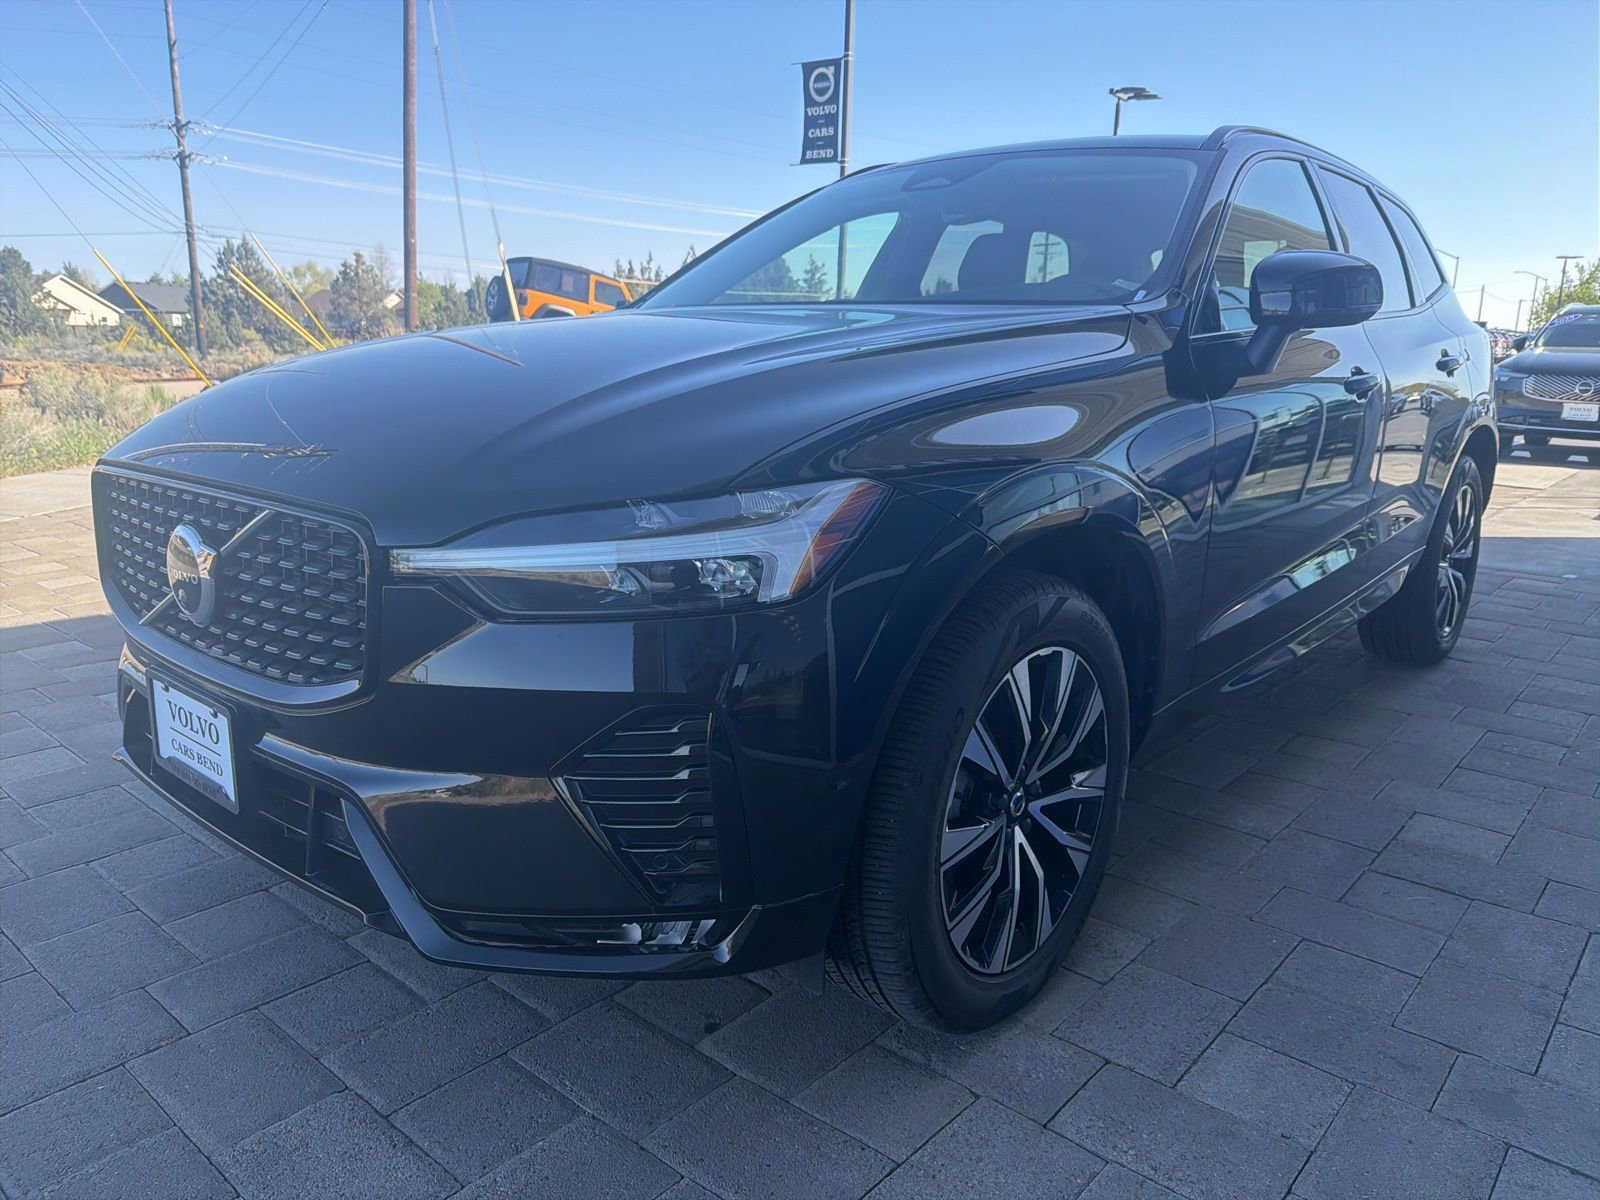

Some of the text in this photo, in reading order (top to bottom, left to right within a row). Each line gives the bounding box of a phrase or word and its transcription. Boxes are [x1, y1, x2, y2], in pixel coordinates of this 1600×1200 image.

[806, 104, 837, 116] VOLVO
[808, 127, 834, 138] CARS
[805, 148, 834, 159] BEND
[166, 699, 220, 745] VOLVO
[171, 738, 223, 777] CARS BEND
